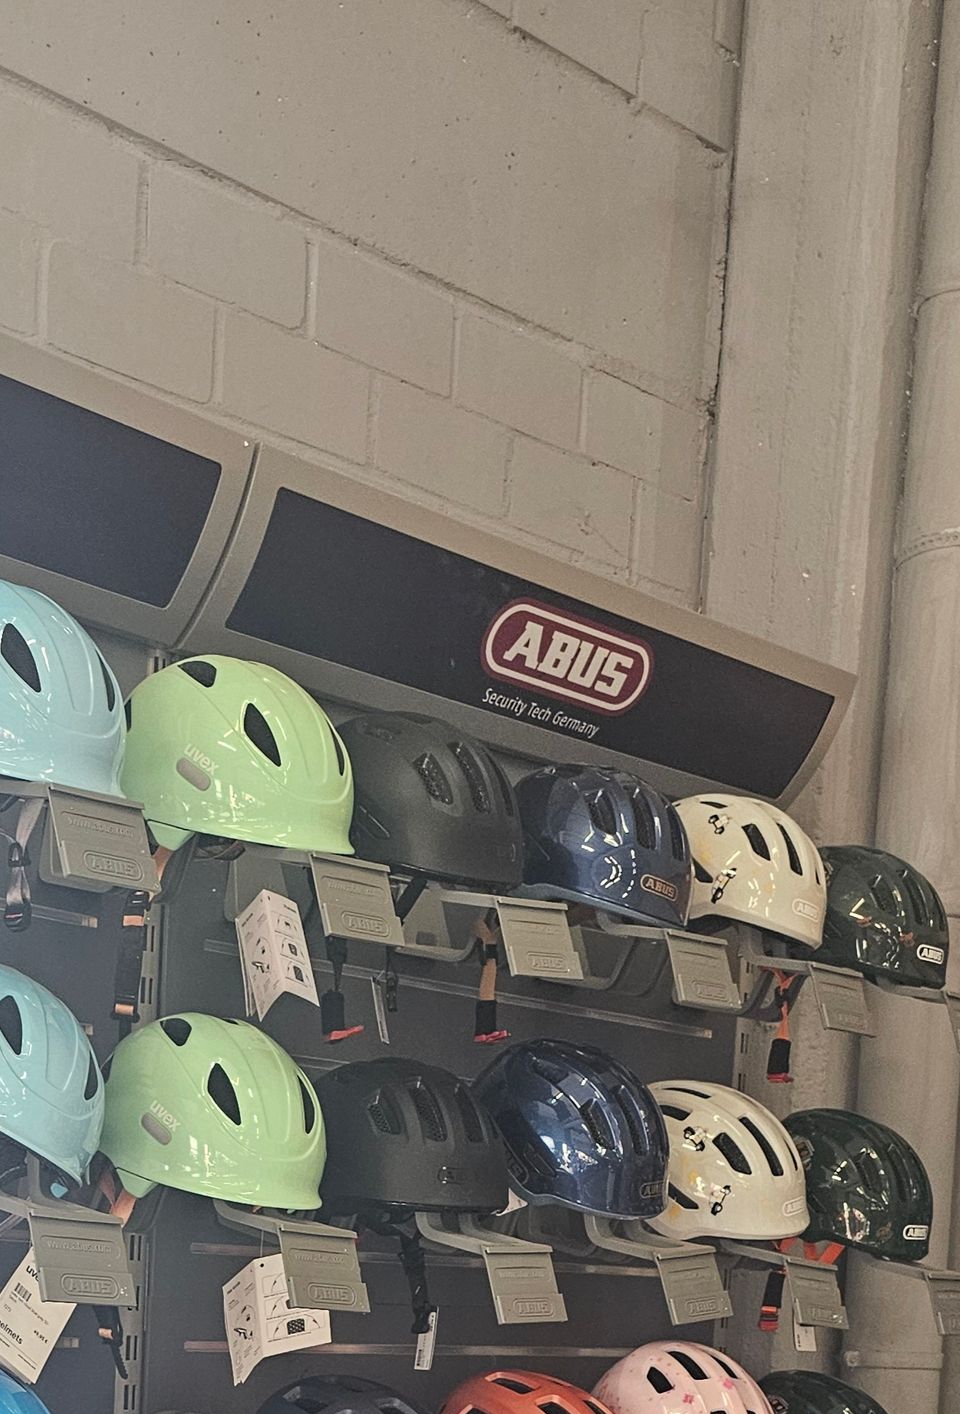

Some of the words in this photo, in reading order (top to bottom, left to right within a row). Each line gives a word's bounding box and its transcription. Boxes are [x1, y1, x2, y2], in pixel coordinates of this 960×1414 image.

[504, 621, 634, 697] ABUS
[482, 688, 527, 715] Security
[528, 702, 551, 721] Tech
[552, 710, 599, 739] Germany
[184, 744, 219, 776] uvex
[646, 878, 675, 898] ABUS
[150, 1100, 181, 1132] uvex
[26, 1265, 40, 1281] uve
[67, 1277, 110, 1295] ABUS
[313, 1287, 350, 1301] ABUS
